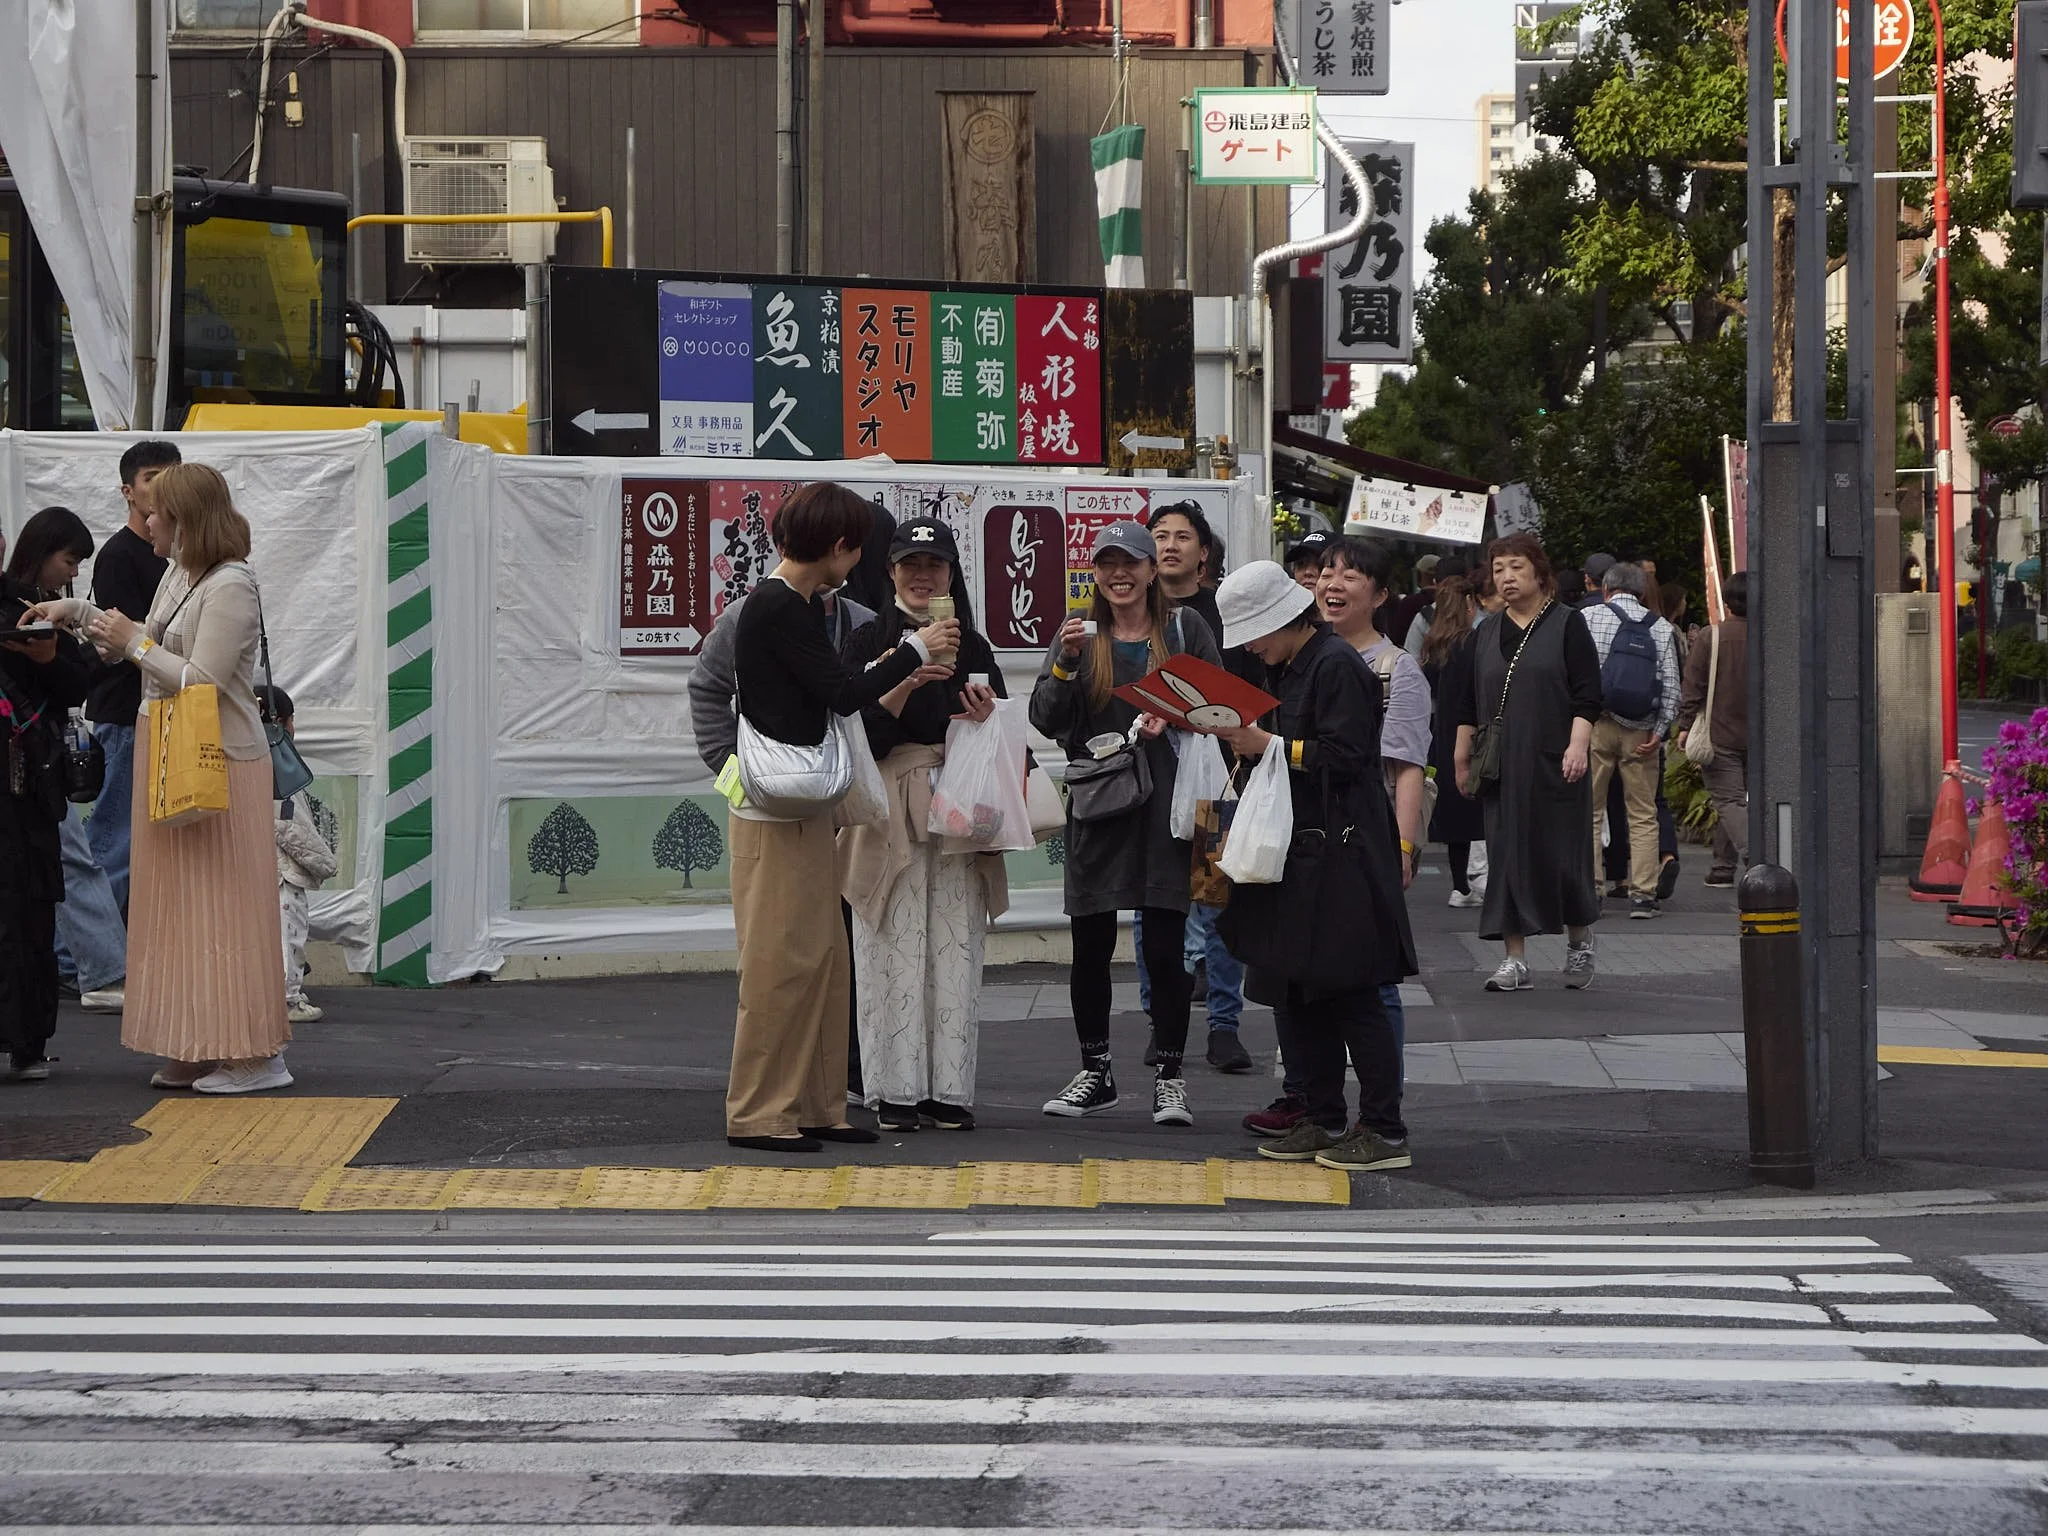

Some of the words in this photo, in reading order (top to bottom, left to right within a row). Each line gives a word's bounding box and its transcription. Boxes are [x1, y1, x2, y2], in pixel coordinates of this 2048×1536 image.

[1312, 1, 1336, 76] うじ茶
[1220, 138, 1292, 162] ゲート
[1228, 113, 1311, 131] 飛島建設
[1335, 152, 1405, 349] 森乃園
[674, 313, 737, 326] セレクトショップ
[690, 299, 722, 311] 和ギフト
[820, 290, 840, 374] 京粕漬
[1082, 303, 1099, 350] 名物
[755, 291, 813, 456] 魚久
[856, 304, 882, 448] スタジオ
[891, 305, 916, 413] モリヤ
[941, 304, 963, 397] 不動産
[1041, 301, 1079, 456] 人形焼
[672, 415, 693, 429] 文具
[698, 416, 743, 430] 事務用品
[707, 442, 742, 455] ミヤギ
[1018, 383, 1038, 459] 板倉屋
[624, 494, 633, 539] ほうじ茶
[1077, 495, 1131, 510] この先すぐ
[1369, 509, 1411, 526] ほうじ茶
[647, 543, 675, 616] 森乃園
[687, 494, 696, 617] からだにいいをおいしくする
[1006, 510, 1043, 644] 鳥忠
[636, 631, 681, 643] この先すぐ
